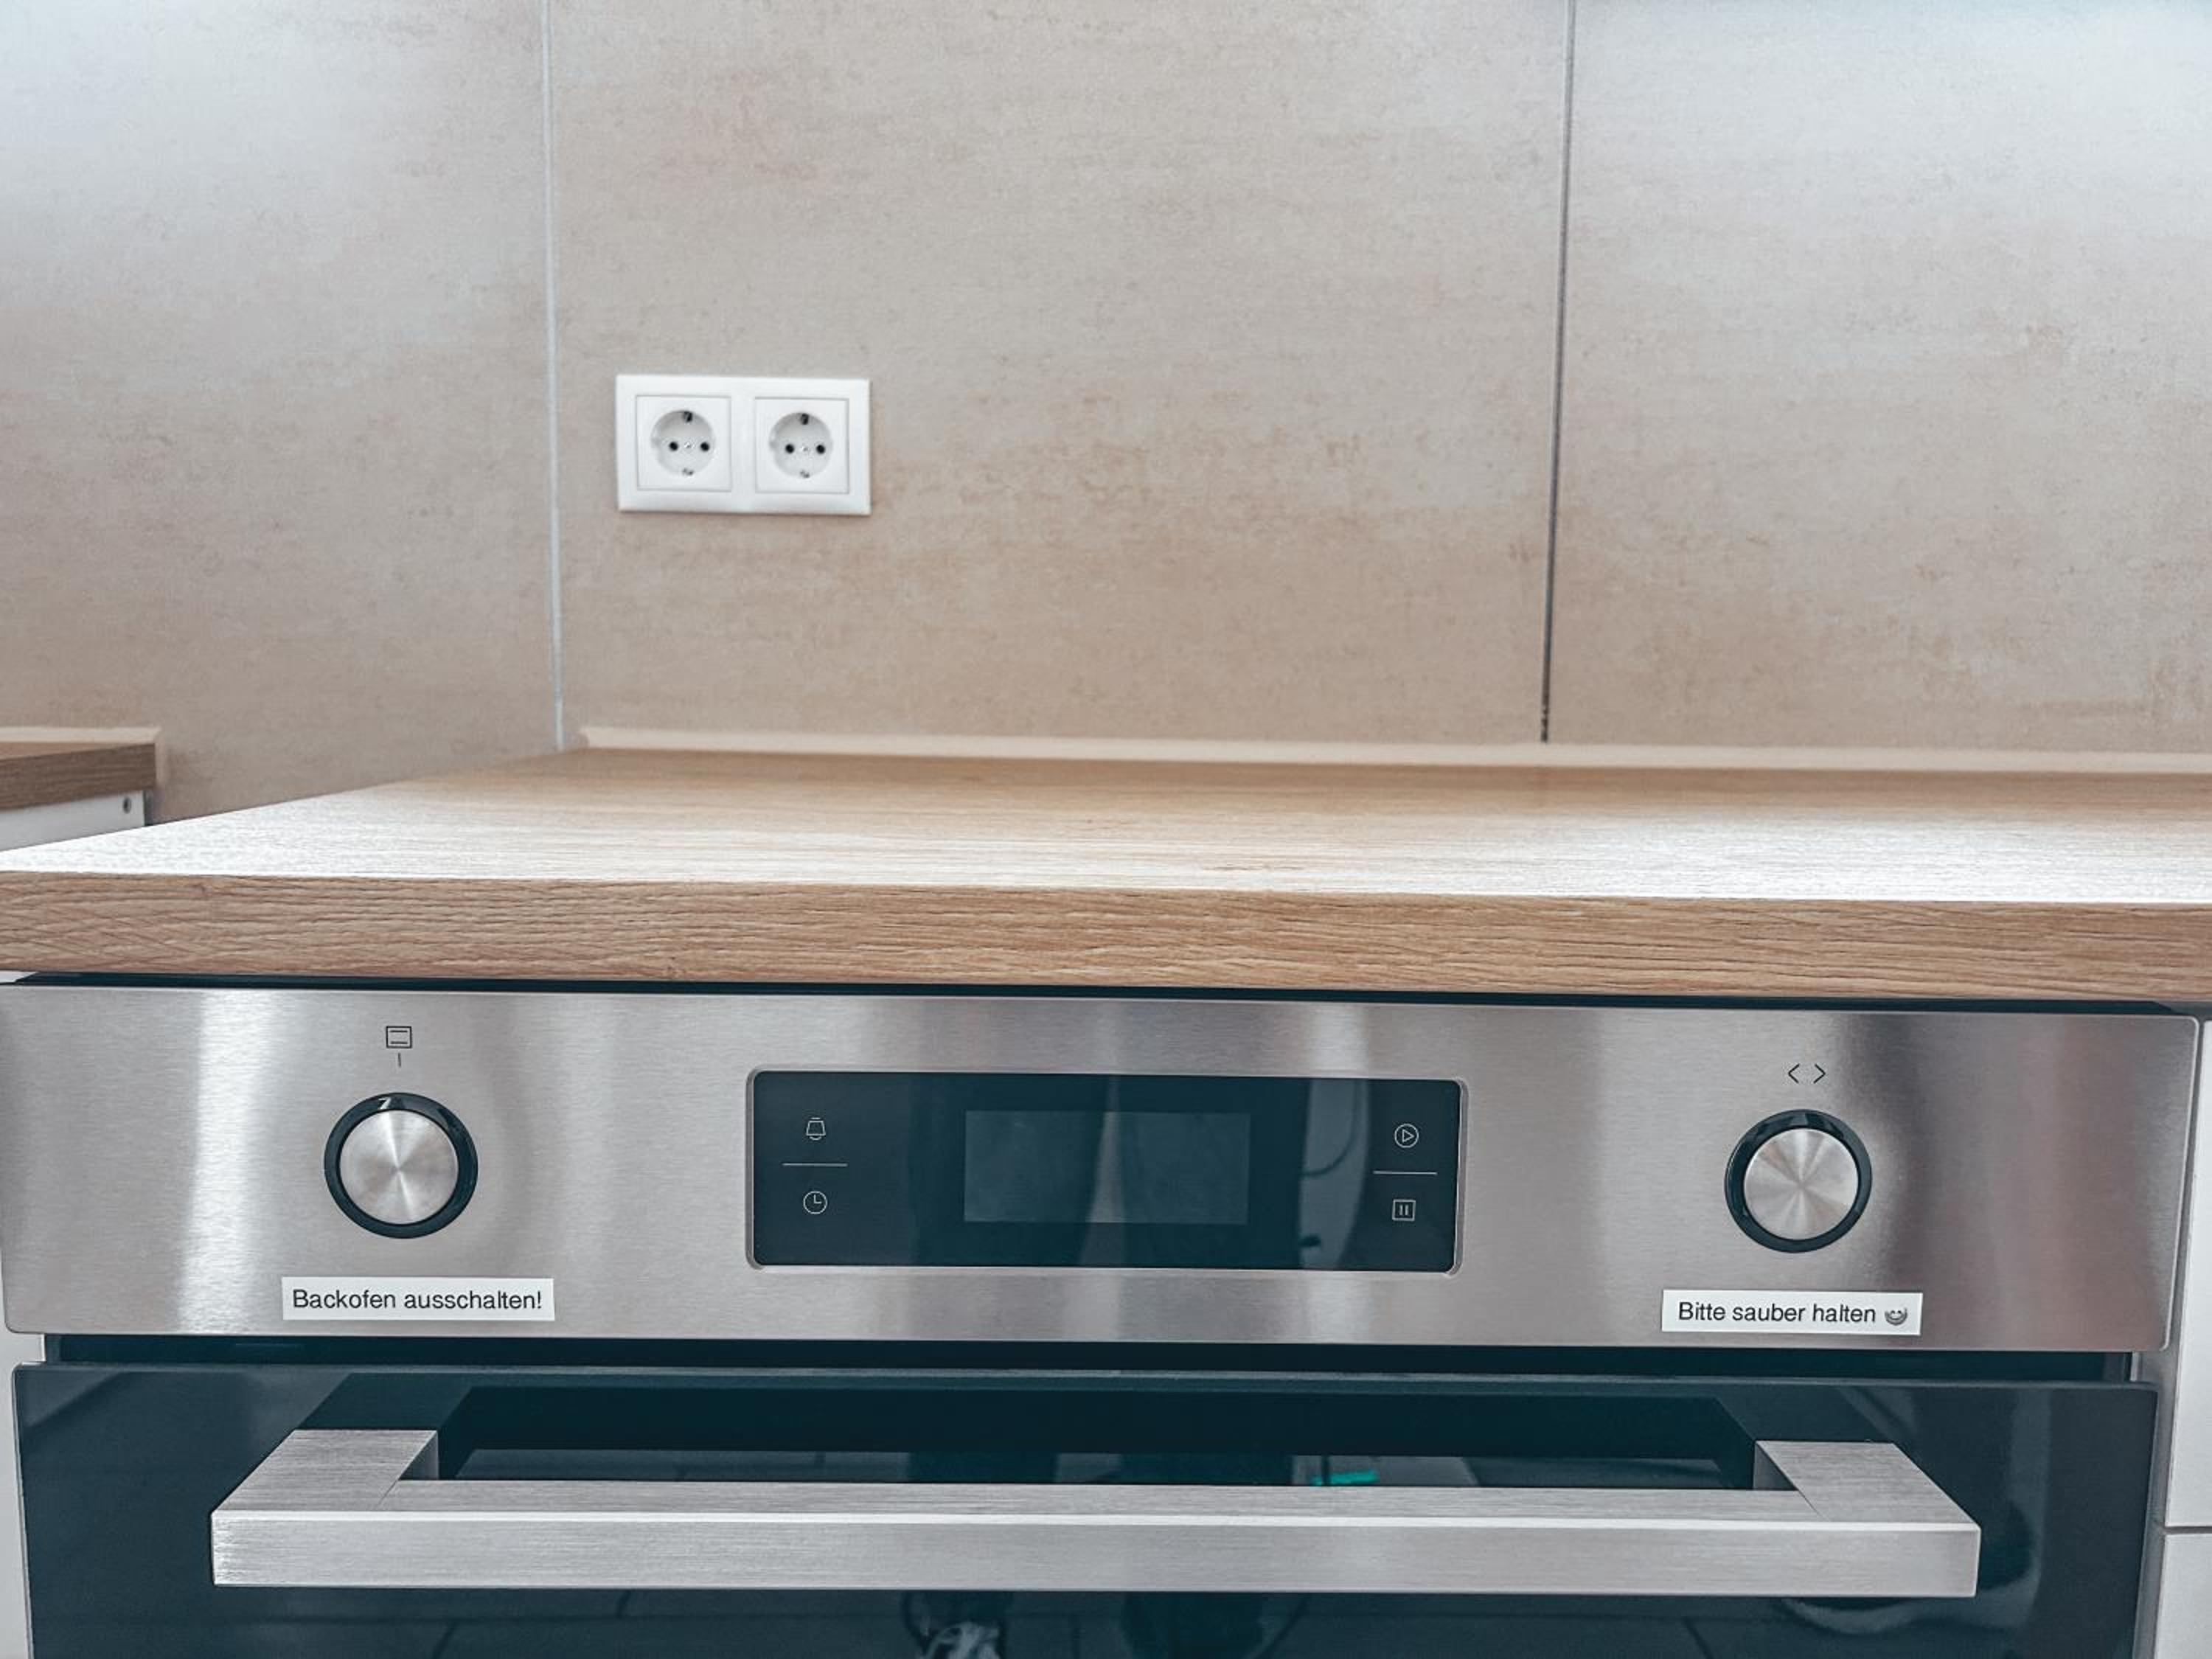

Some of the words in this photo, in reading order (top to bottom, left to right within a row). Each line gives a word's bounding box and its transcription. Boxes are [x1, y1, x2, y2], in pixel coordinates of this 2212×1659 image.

[293, 1289, 396, 1309] Backofen
[404, 1290, 542, 1310] ausschalten!
[1679, 1301, 1726, 1321] Bitte
[1732, 1303, 1806, 1322] sauber
[1812, 1303, 1876, 1323] halten
